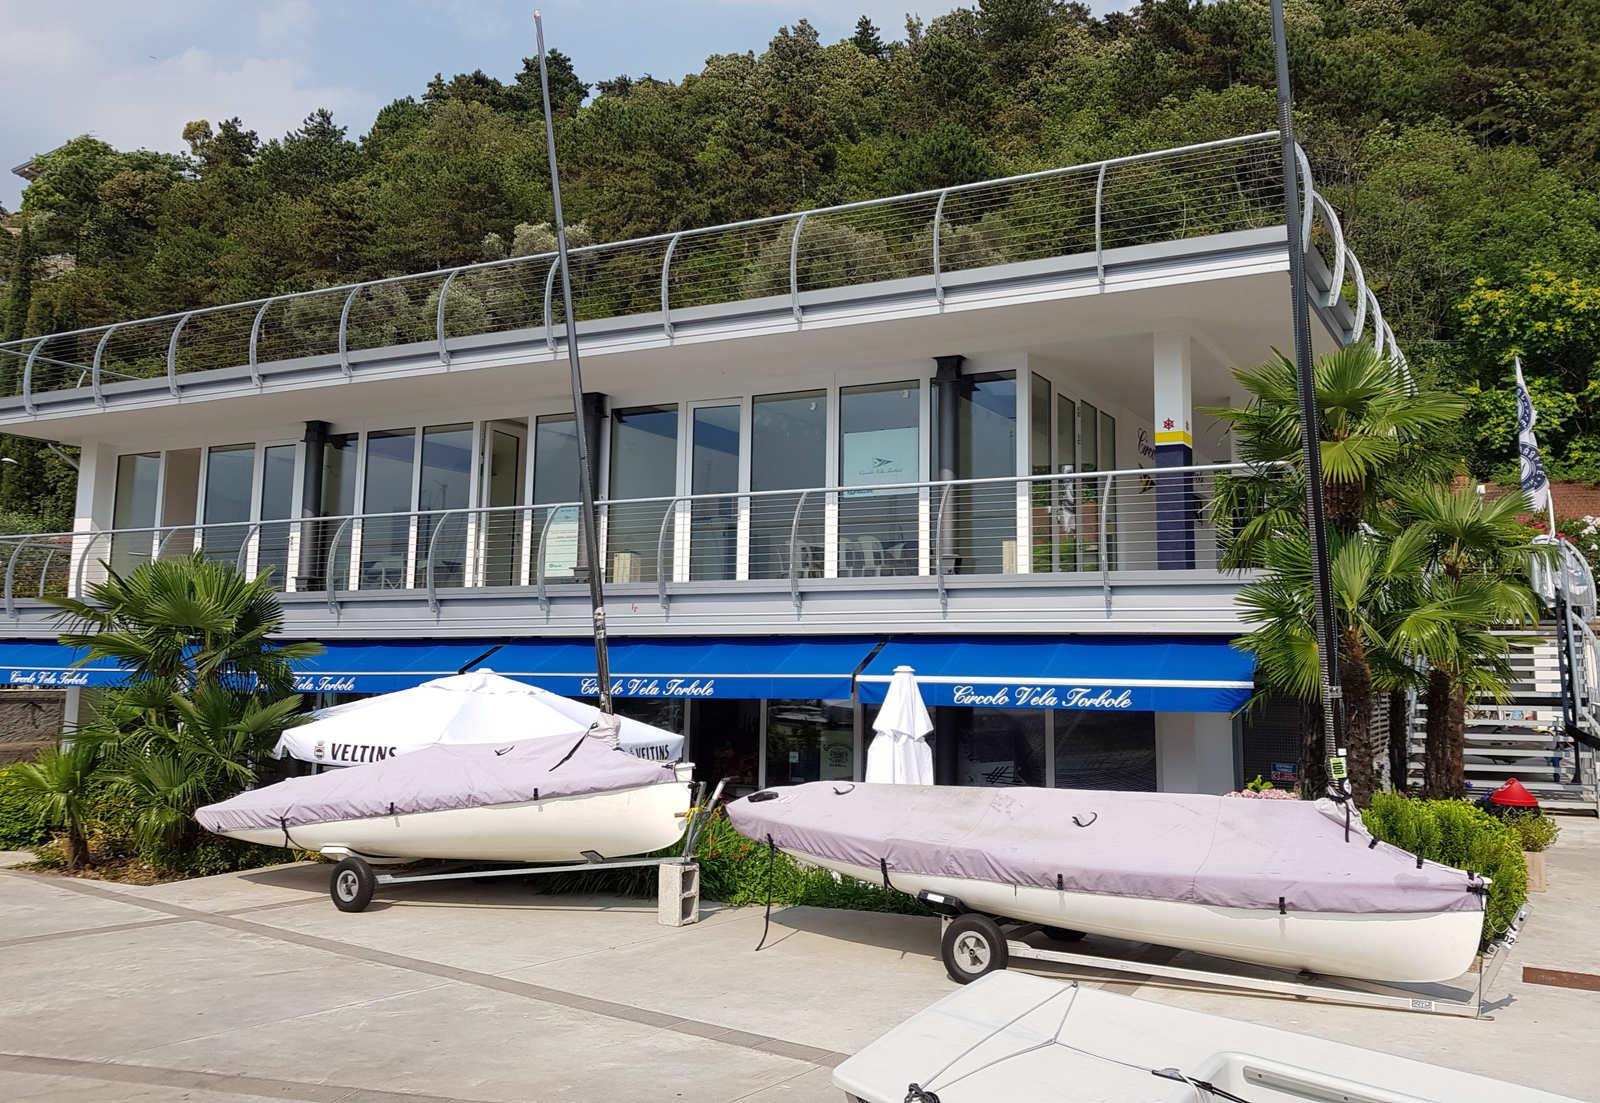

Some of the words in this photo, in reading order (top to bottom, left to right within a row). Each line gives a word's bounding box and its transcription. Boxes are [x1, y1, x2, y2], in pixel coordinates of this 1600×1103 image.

[315, 676, 356, 691] Torbole
[581, 678, 624, 695] Cirlo
[627, 678, 660, 696] Vela
[662, 678, 715, 697] Torbole
[953, 685, 1010, 705] Circolo
[1014, 686, 1058, 706] Vela
[1062, 687, 1134, 708] Torbole
